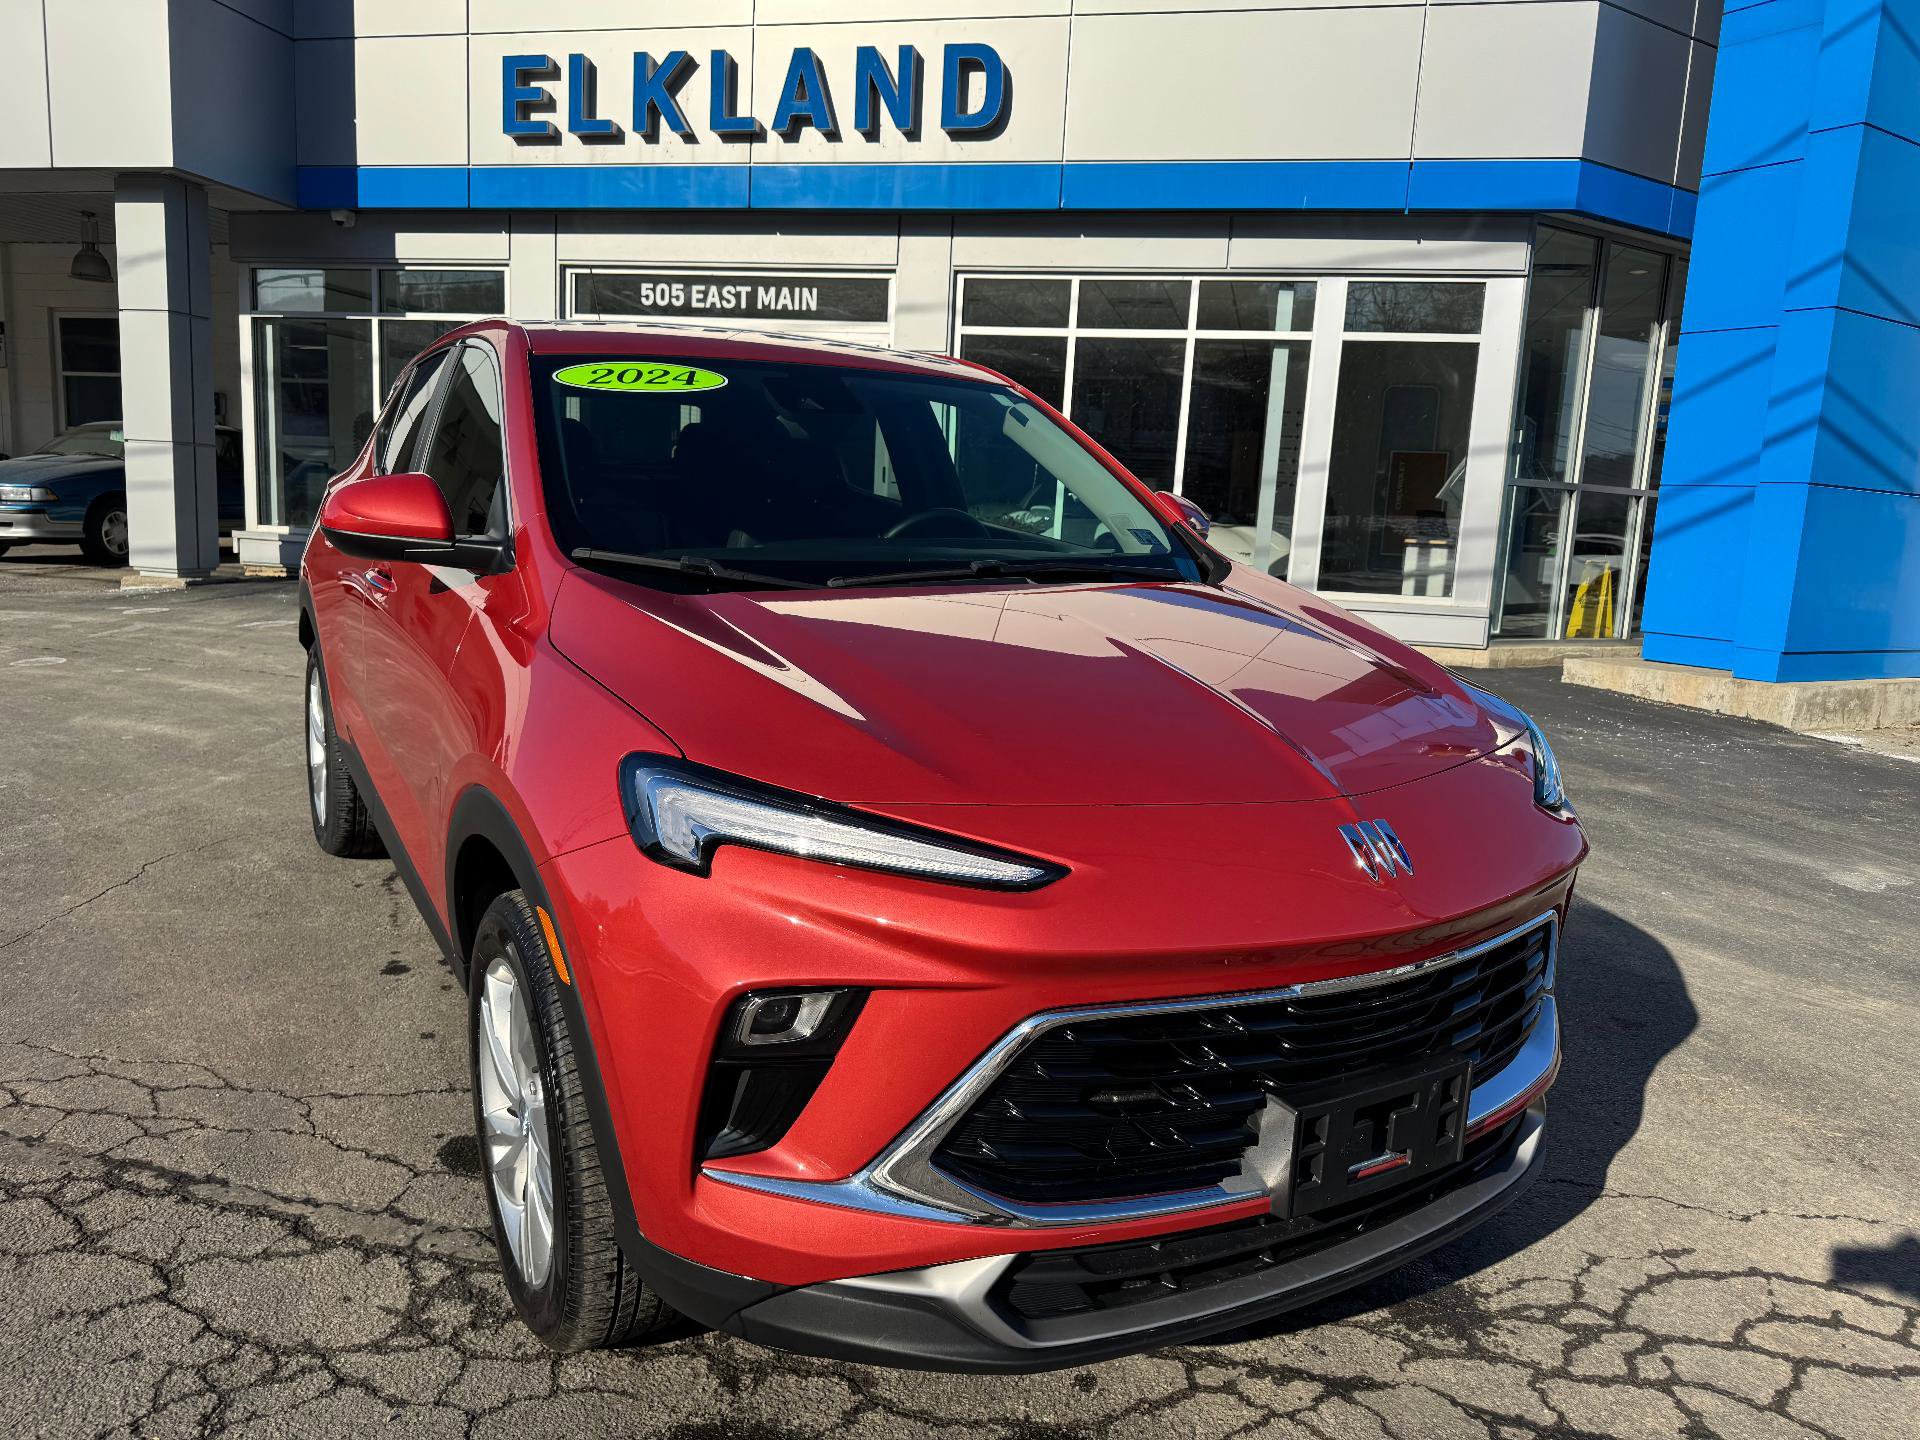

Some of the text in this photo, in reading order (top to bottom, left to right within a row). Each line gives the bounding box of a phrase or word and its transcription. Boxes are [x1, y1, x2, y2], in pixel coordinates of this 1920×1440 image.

[502, 43, 1009, 139] ELKLAND
[640, 282, 818, 311] 505 EAST MAIN
[586, 367, 701, 387] 2024
